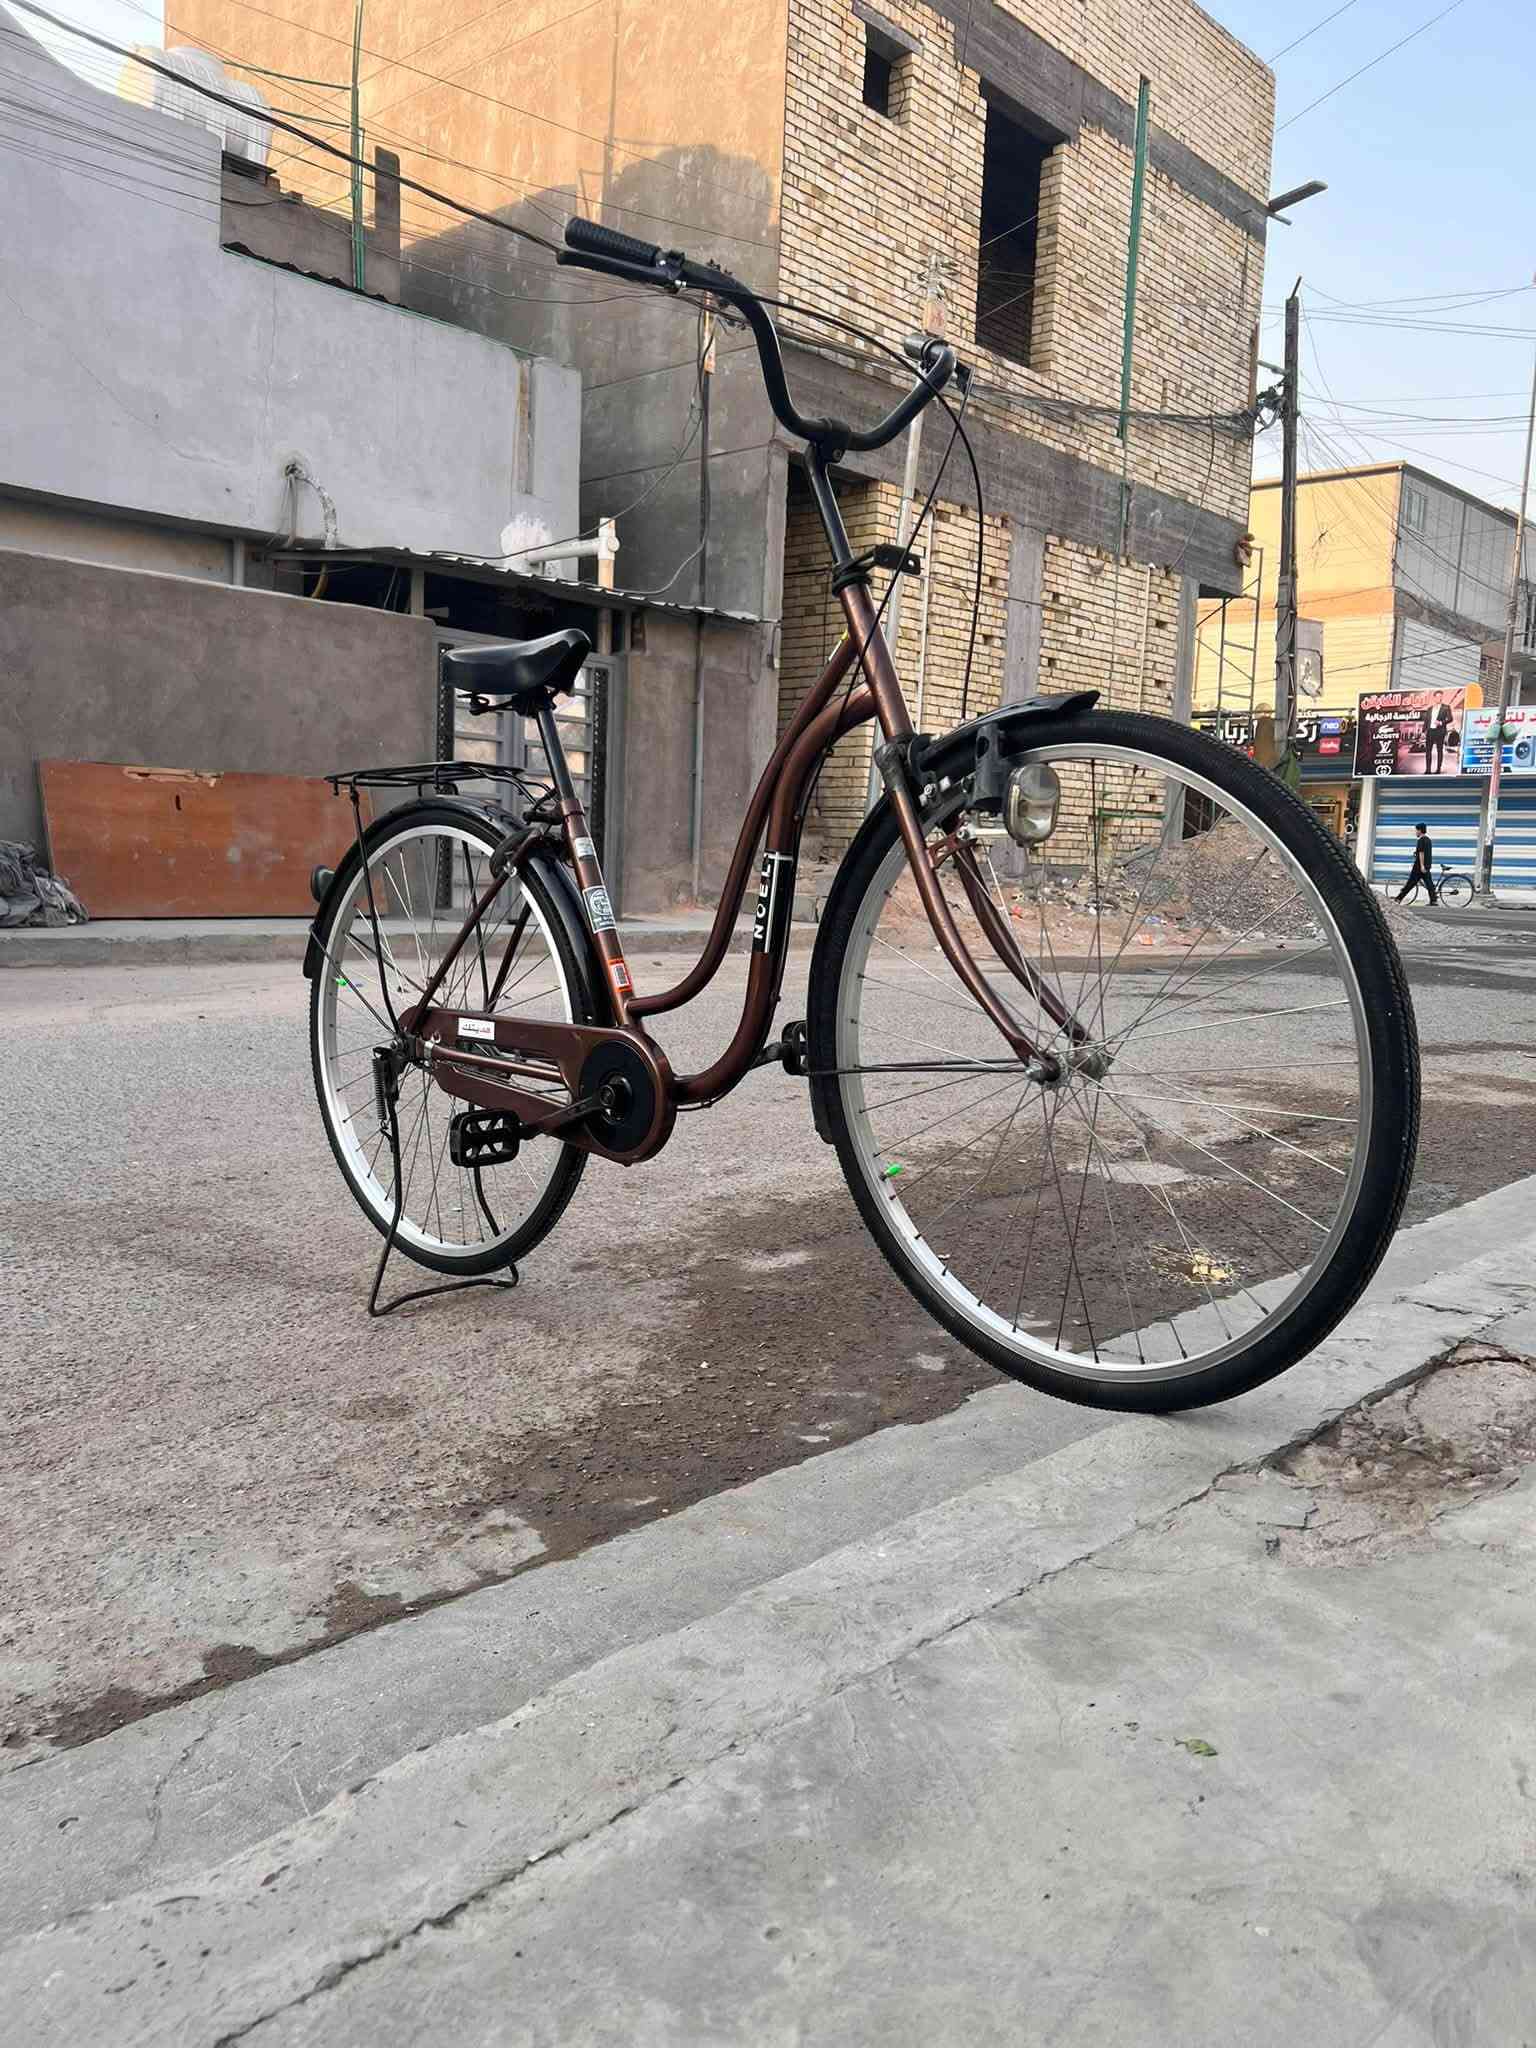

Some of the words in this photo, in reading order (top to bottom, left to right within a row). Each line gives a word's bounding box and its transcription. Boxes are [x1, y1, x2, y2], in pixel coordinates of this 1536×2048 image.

[1365, 712, 1392, 722] الرجالية
[1372, 732, 1400, 740] LACOSTE
[753, 864, 771, 940] NOEL
